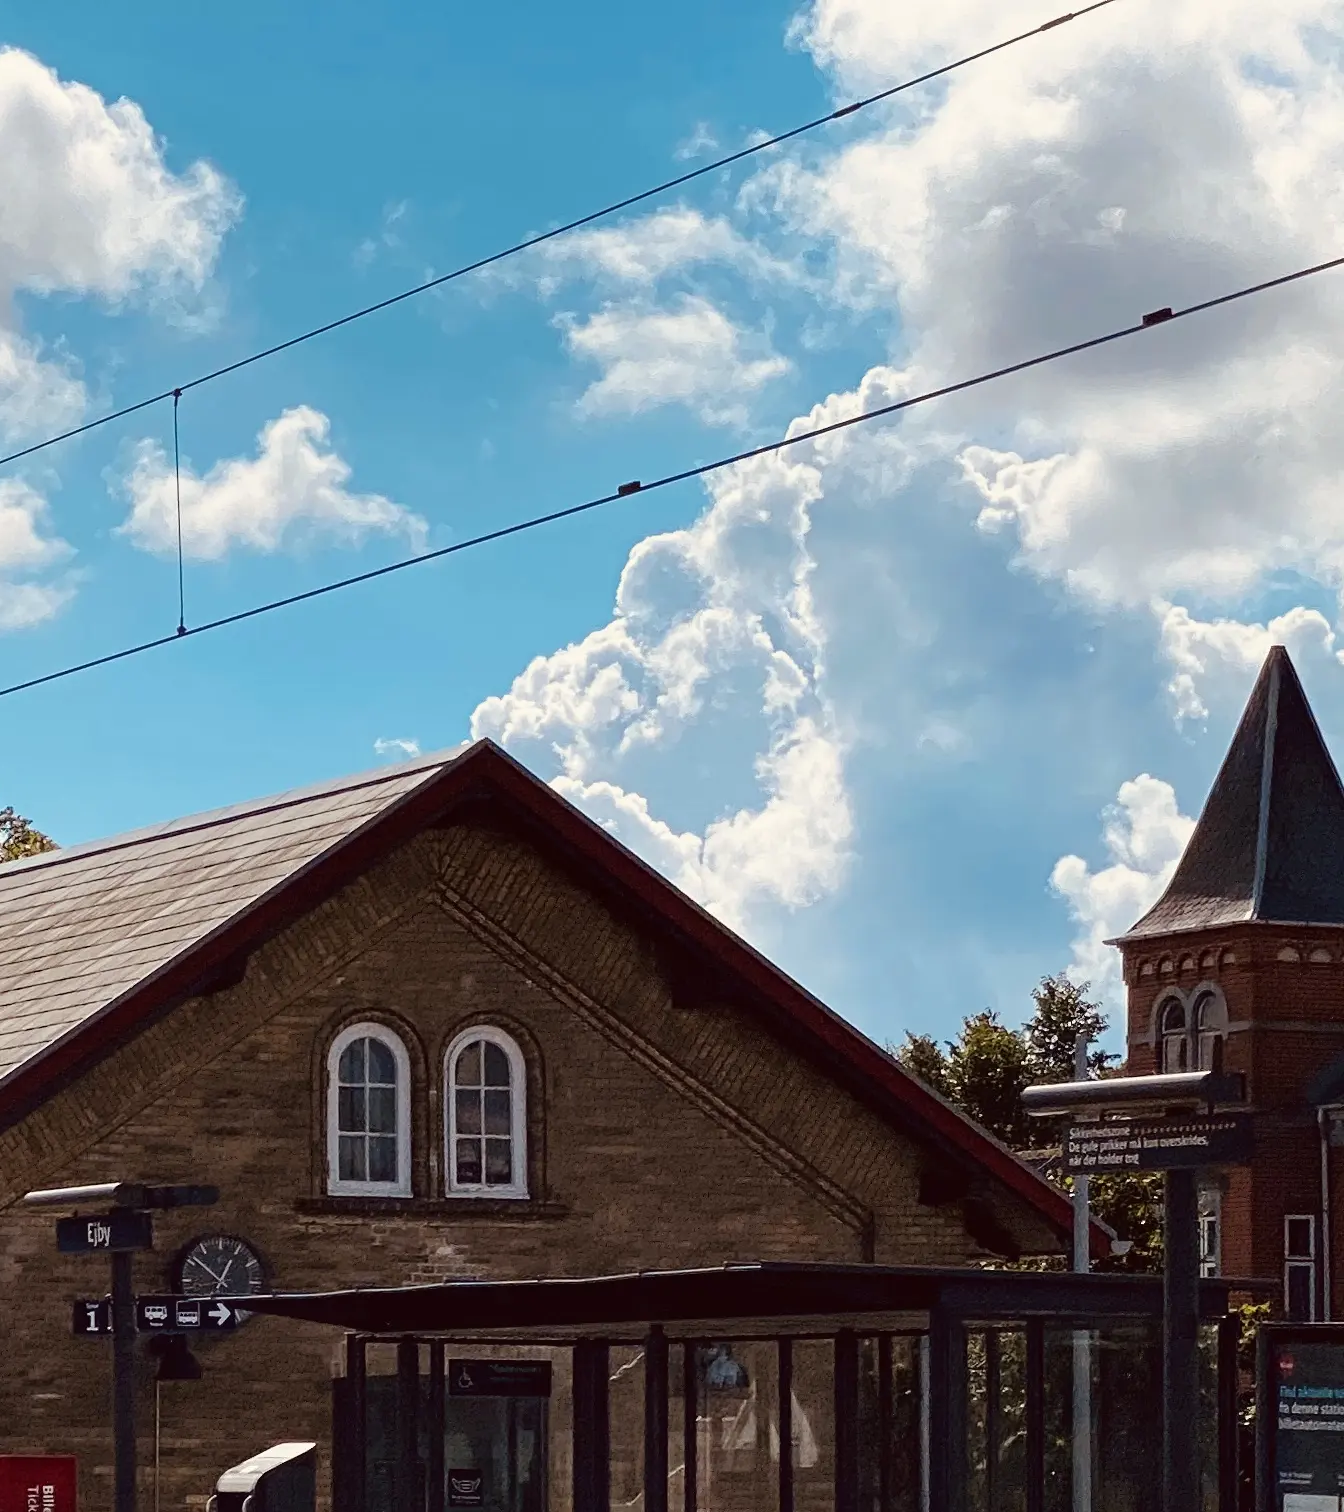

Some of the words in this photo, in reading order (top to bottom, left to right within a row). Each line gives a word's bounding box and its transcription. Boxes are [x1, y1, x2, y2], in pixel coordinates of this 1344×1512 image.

[1069, 1142, 1081, 1153] De
[1083, 1154, 1097, 1166] der
[87, 1221, 111, 1247] Ejby
[86, 1311, 99, 1331] 1
